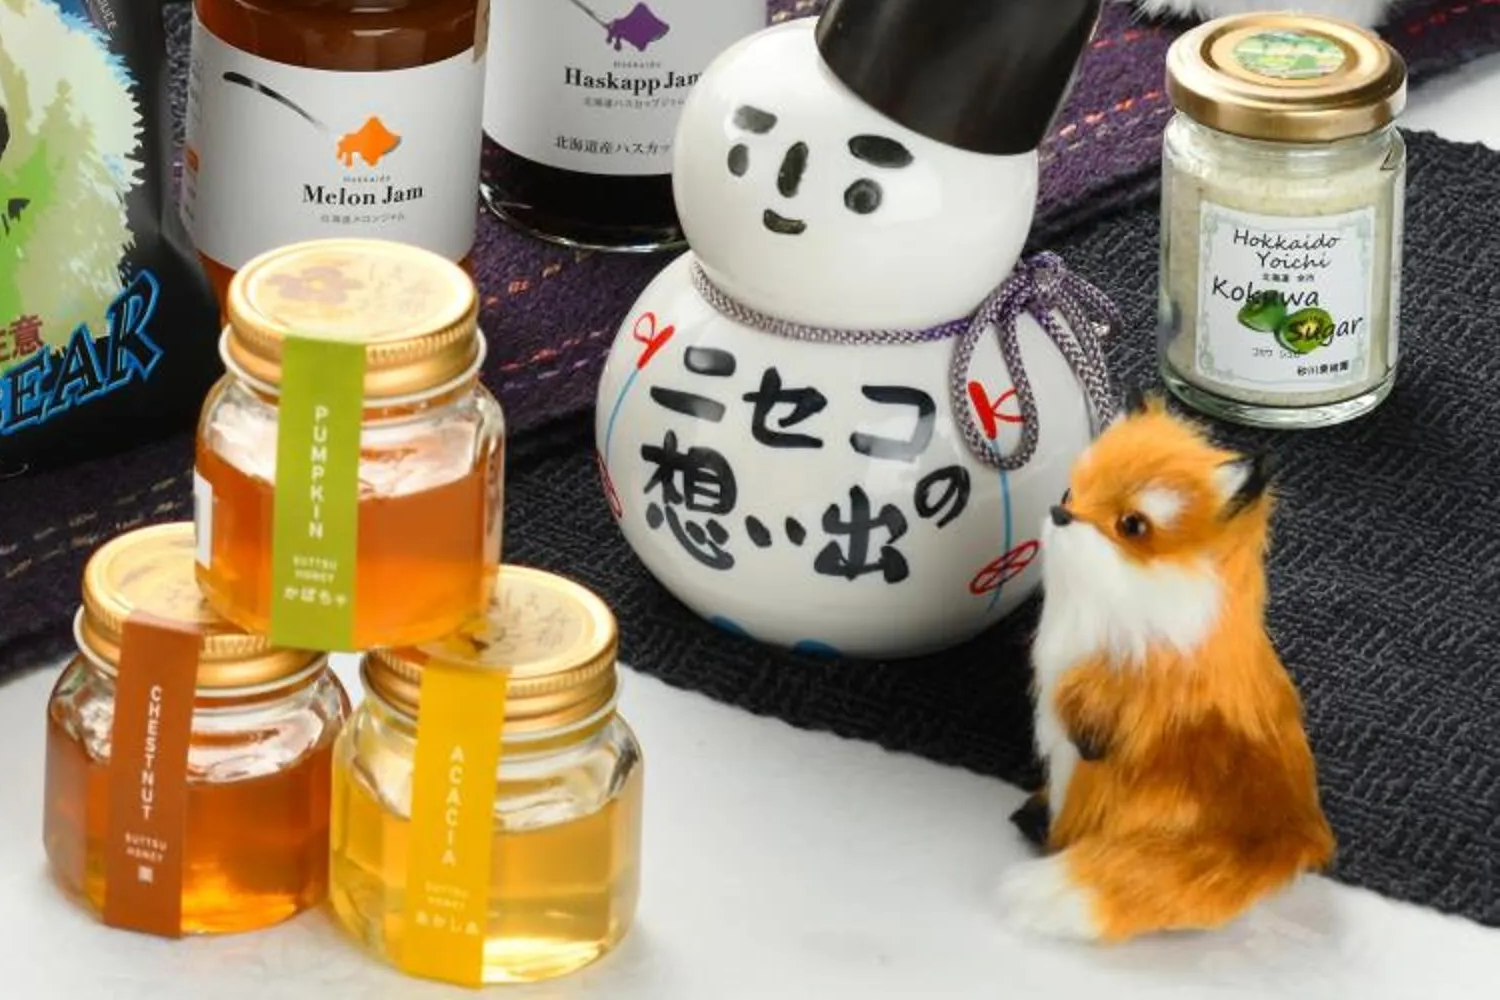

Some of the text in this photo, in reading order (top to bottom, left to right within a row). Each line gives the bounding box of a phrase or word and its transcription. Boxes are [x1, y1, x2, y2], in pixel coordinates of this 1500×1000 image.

[564, 66, 661, 97] Haskapp
[302, 183, 423, 206] Melon Jam
[1233, 229, 1341, 250] Hokkaido
[1256, 251, 1331, 269] Yoichi
[651, 345, 936, 463] ニセコ
[308, 405, 330, 540] PUMPKIN
[140, 685, 163, 820] CHESTNUT
[441, 744, 465, 867] ACACIA
